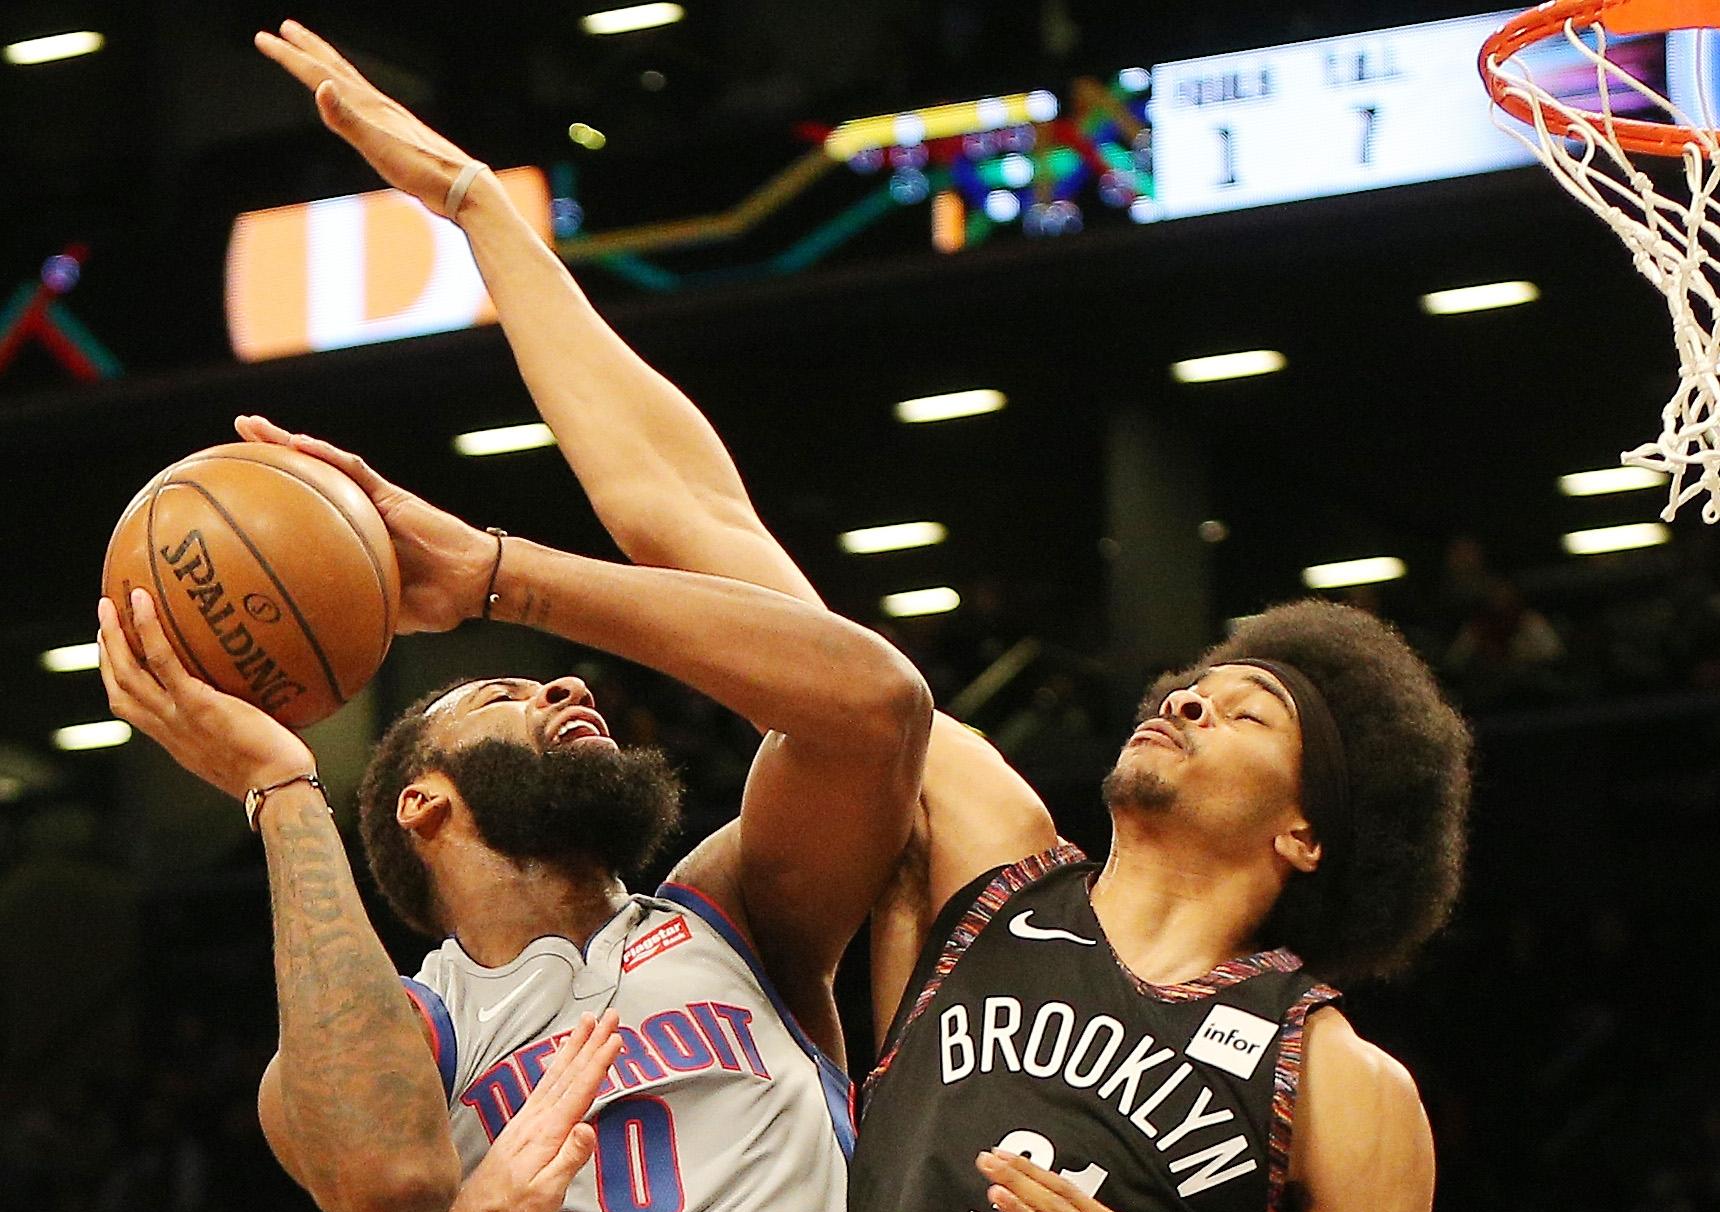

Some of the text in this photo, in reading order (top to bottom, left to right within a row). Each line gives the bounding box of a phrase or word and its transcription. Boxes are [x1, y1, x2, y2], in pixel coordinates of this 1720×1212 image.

[160, 528, 306, 716] SPALDING
[623, 922, 682, 963] Flagstar
[459, 1001, 772, 1146] DEROIT
[940, 996, 1257, 1199] BROOKLYN
[1203, 1022, 1261, 1057] infor
